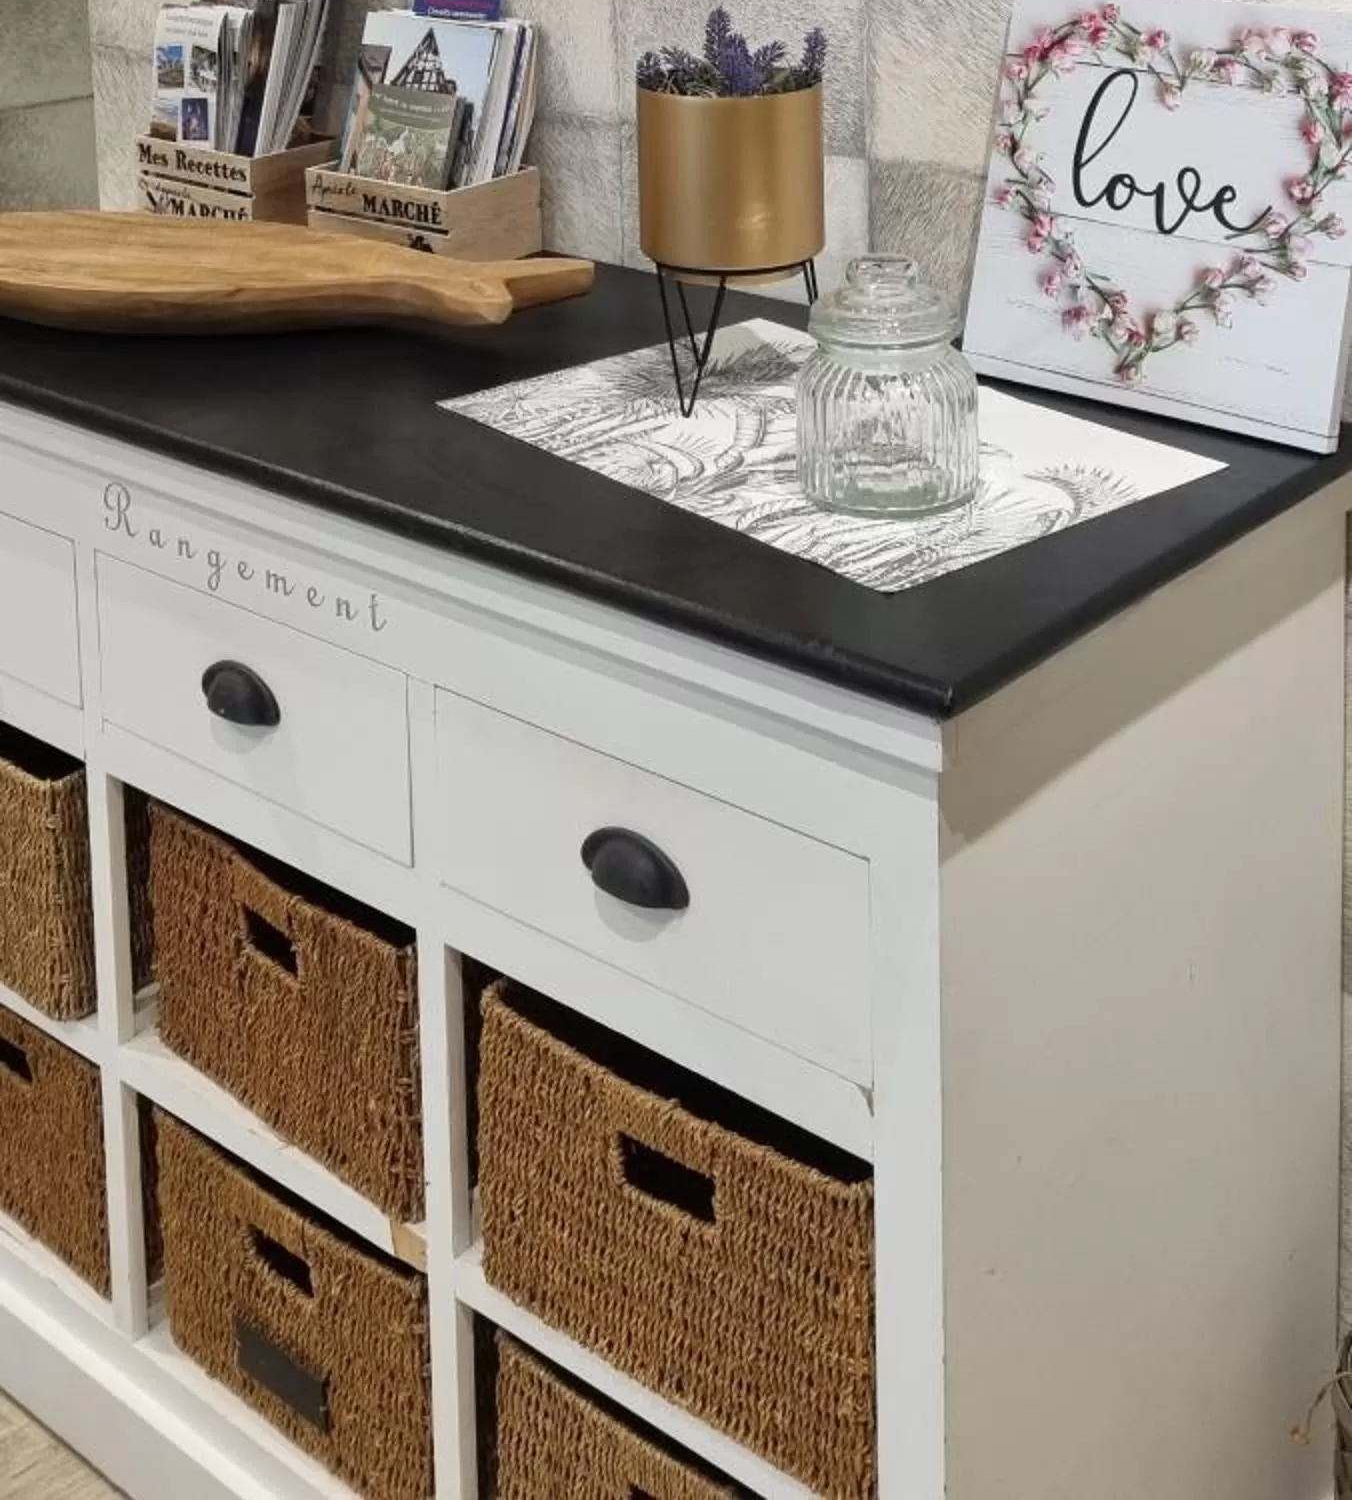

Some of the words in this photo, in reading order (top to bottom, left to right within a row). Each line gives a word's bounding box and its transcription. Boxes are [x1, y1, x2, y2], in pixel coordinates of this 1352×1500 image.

[138, 142, 168, 166] Mes
[175, 149, 248, 182] Recettes
[1071, 69, 1272, 235] love
[362, 193, 442, 225] MARCHÉ
[103, 482, 388, 632] Rangement
